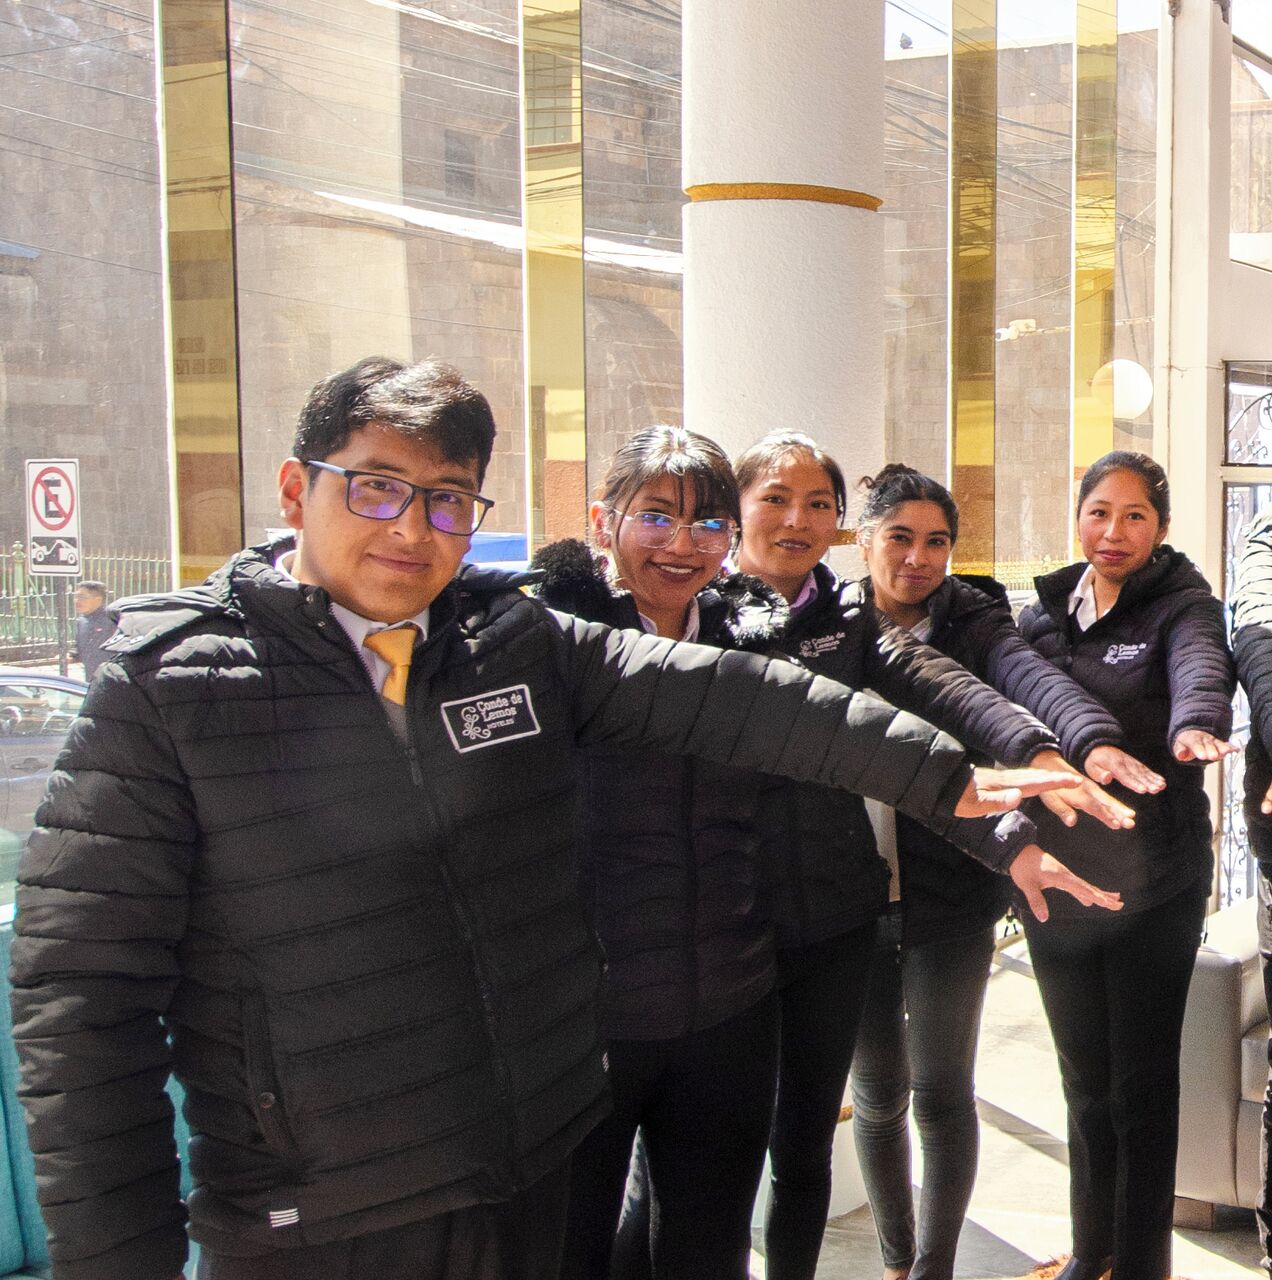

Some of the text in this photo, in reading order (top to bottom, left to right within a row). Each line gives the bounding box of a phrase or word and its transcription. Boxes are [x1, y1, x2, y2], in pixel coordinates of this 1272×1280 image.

[43, 478, 64, 518] E
[476, 693, 523, 712] Conde de
[481, 707, 517, 722] Lemos
